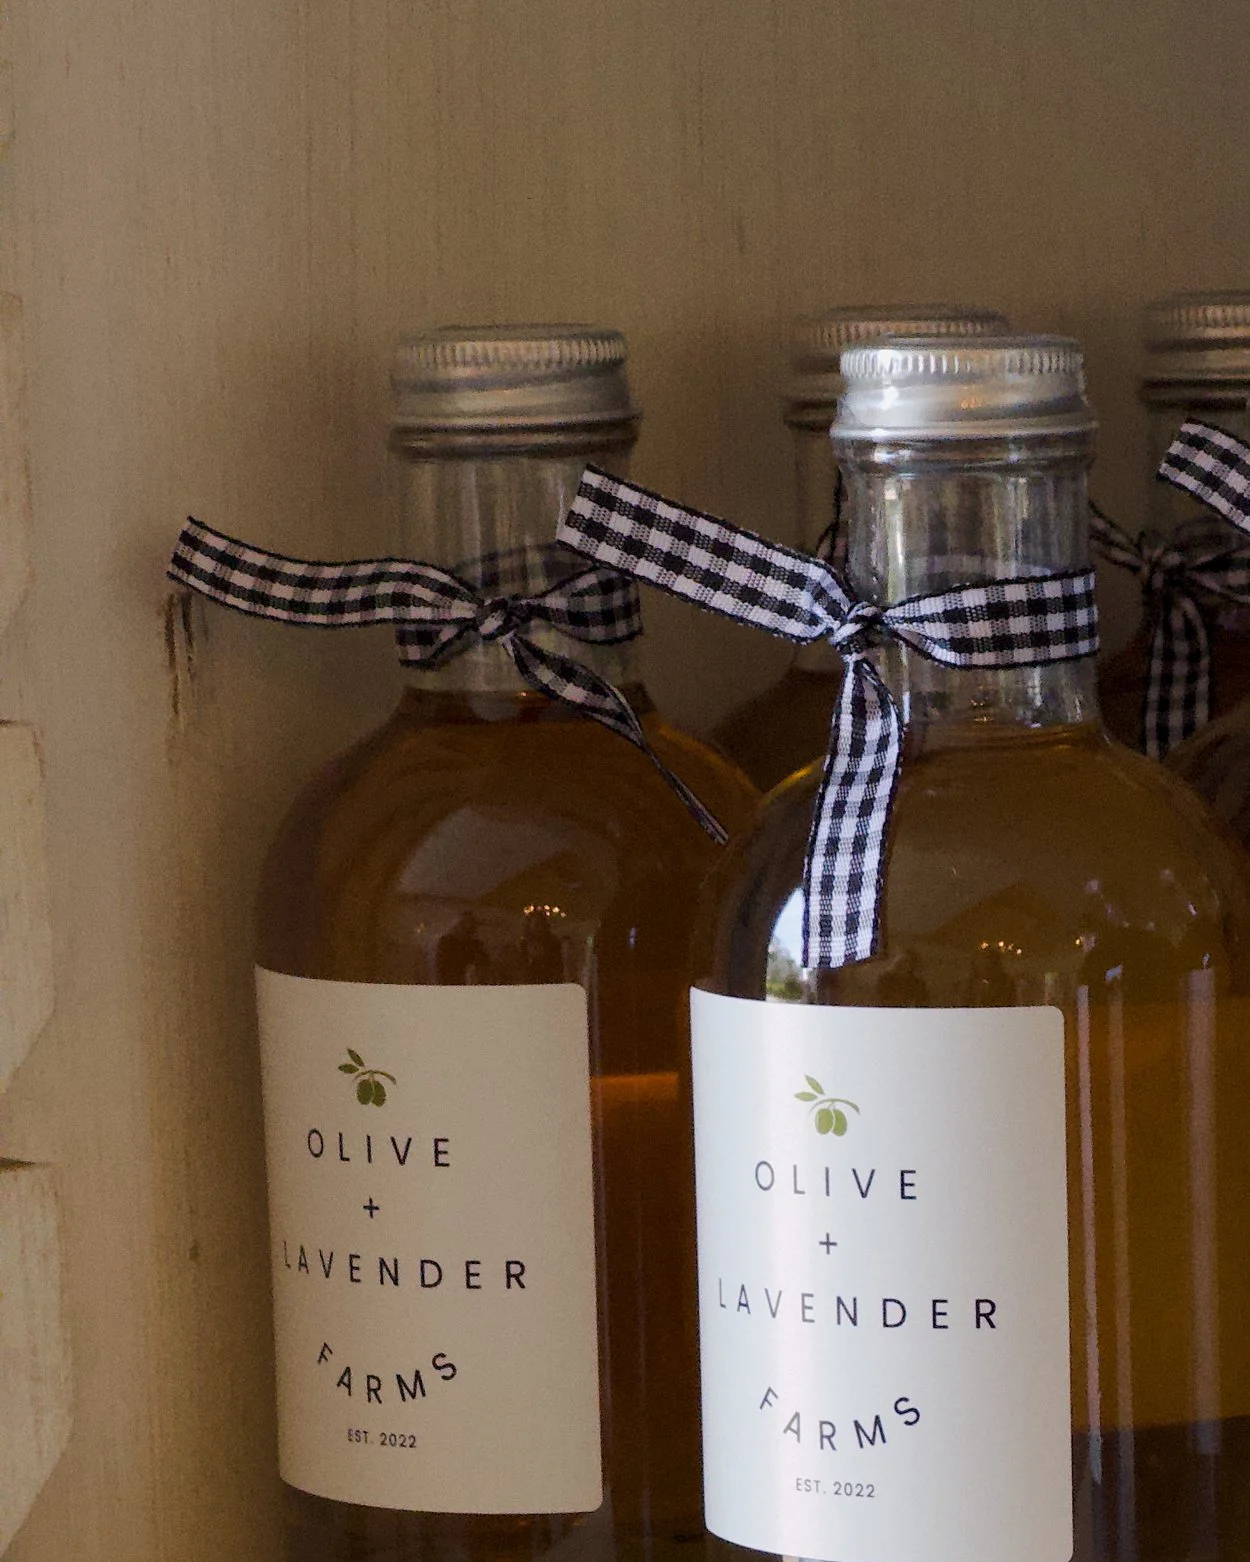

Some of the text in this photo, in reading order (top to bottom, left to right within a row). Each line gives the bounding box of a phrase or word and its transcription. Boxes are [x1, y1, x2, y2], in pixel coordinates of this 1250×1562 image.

[308, 1129, 450, 1167] OLIVE
[755, 1161, 916, 1200] OLIVE
[362, 1197, 380, 1219] +
[818, 1232, 838, 1255] +
[283, 1240, 526, 1290] LAVENDER
[718, 1278, 997, 1330] LAVENDER
[318, 1343, 457, 1403] FARMS
[347, 1428, 416, 1448] EST. 2022
[760, 1388, 920, 1450] FARMS
[796, 1477, 875, 1498] EST. 2022
